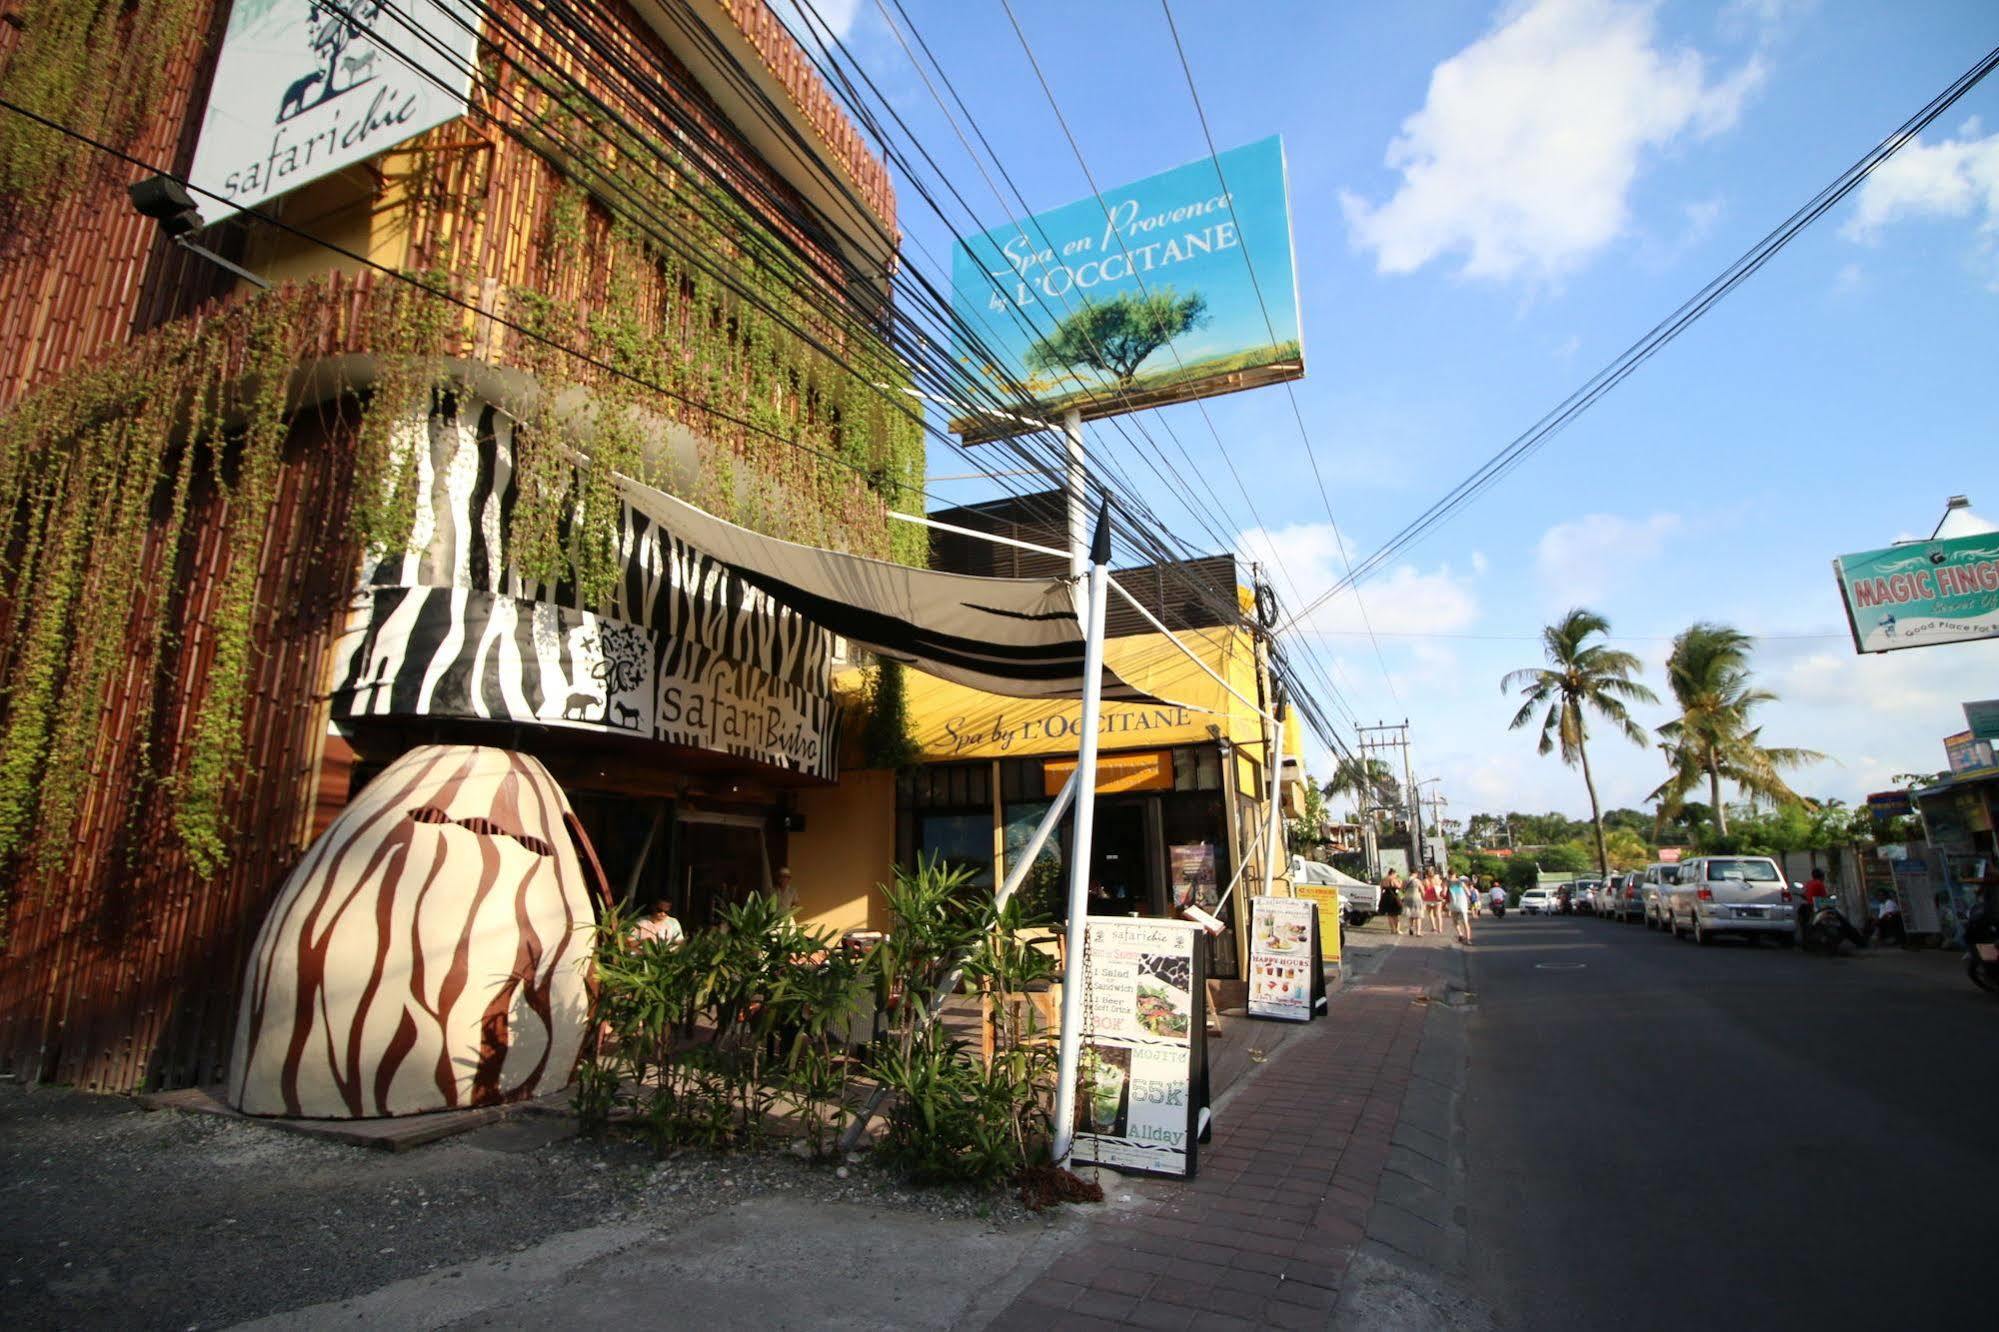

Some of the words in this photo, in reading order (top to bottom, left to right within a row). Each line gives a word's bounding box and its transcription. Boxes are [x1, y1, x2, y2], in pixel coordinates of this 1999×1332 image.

[222, 84, 417, 200] safarichic
[990, 233, 1052, 277] Spa
[1063, 236, 1093, 257] en
[1100, 191, 1234, 252] Provence
[1016, 221, 1238, 308] L'OCCITANE
[1853, 569, 1935, 608] MAGIC
[1935, 559, 1999, 598] FING
[1905, 621, 1935, 636] Good
[1939, 621, 1970, 632] Place
[933, 716, 983, 752] Spa
[990, 714, 1016, 750] by
[1022, 708, 1192, 739] L'OCITANE
[1101, 968, 1130, 978] Salad
[1131, 1079, 1184, 1106] 55K
[1128, 1124, 1185, 1146] Allday
